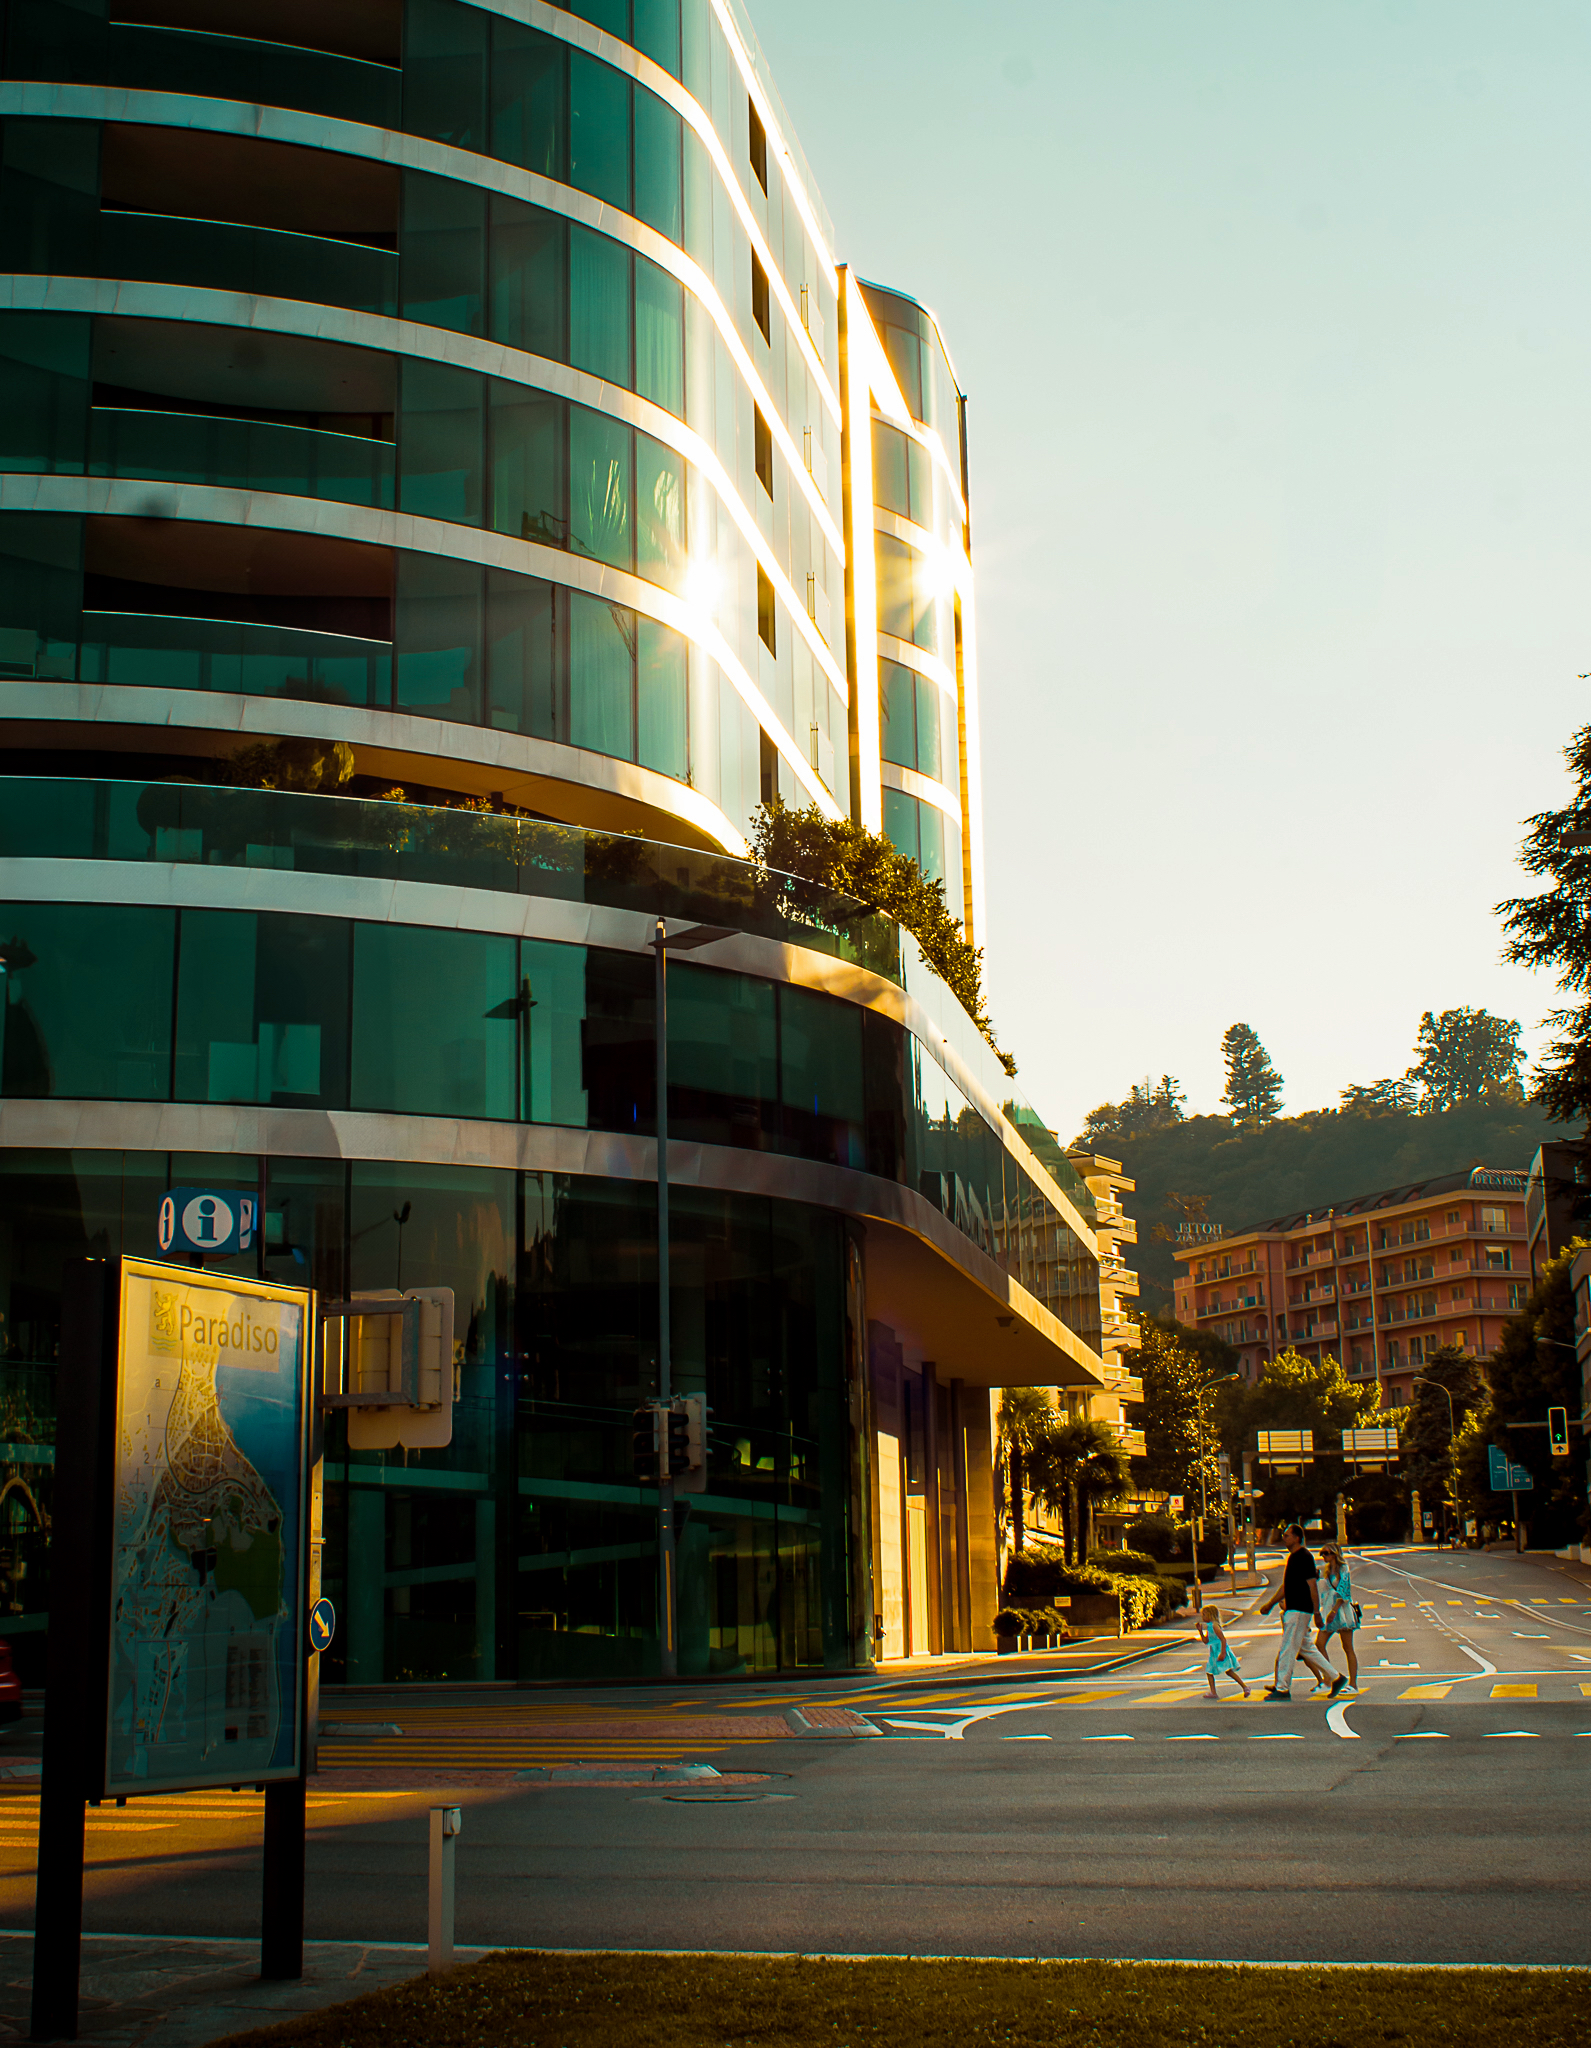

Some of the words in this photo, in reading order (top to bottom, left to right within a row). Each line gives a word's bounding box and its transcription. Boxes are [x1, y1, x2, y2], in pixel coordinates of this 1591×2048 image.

[179, 1304, 278, 1354] Paradiso
[154, 1378, 161, 1388] a
[146, 1413, 151, 1425] 1
[144, 1452, 150, 1465] 2
[142, 1491, 148, 1503] 3
[140, 1570, 146, 1582] 5
